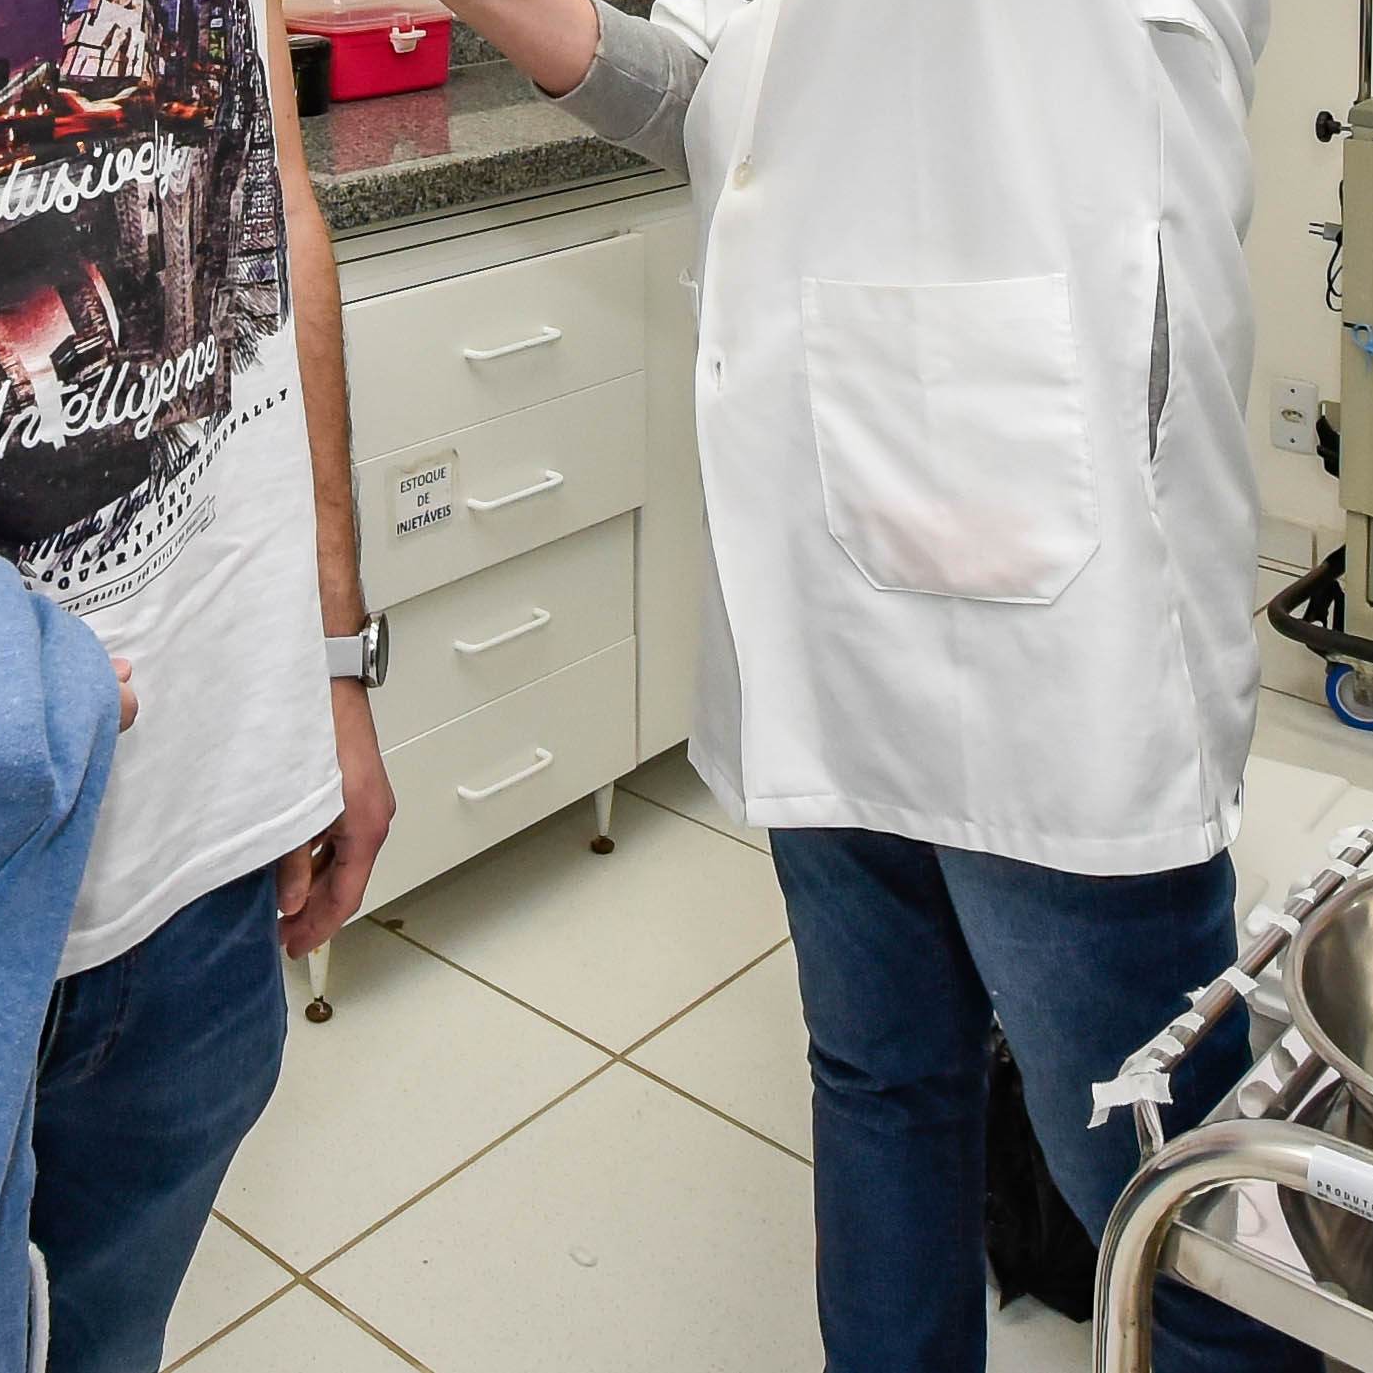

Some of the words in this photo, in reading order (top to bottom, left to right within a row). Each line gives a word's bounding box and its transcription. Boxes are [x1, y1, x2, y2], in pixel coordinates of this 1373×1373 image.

[400, 466, 447, 494] ESTOQUE
[417, 491, 431, 508] DE
[396, 504, 452, 536] INJETÁVEIS
